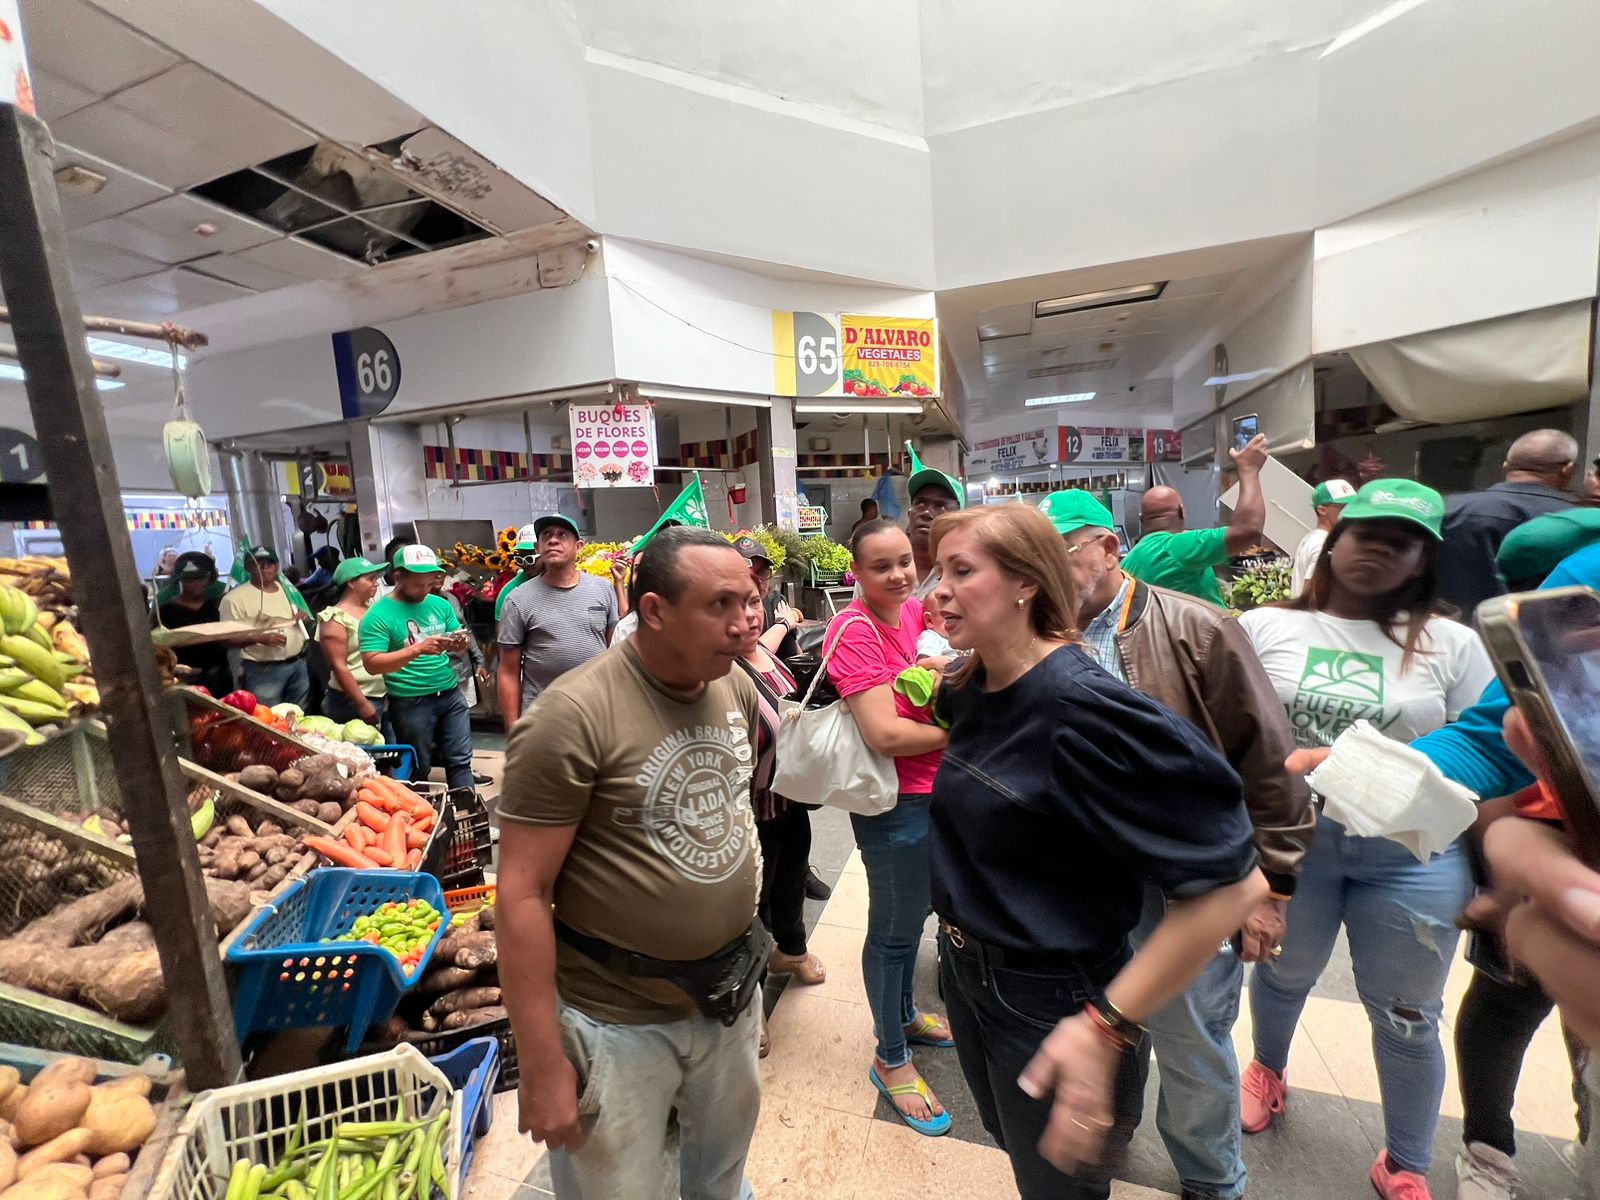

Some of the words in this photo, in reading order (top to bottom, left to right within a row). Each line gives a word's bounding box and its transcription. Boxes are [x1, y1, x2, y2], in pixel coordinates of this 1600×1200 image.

[798, 335, 838, 376] 65
[857, 348, 921, 361] VEGETALES
[357, 349, 393, 394] 66
[578, 409, 641, 426] BUQUES
[575, 427, 592, 439] DE
[597, 426, 646, 438] FLORES
[1066, 435, 1079, 454] 12
[1101, 436, 1119, 447] FELIX
[1153, 437, 1164, 454] 13
[997, 445, 1017, 458] FELIX
[1293, 691, 1385, 725] FUERZA
[635, 727, 695, 787] ORIGINAL
[726, 710, 754, 785] LADA
[659, 763, 687, 805] NEW
[686, 751, 724, 770] YORK
[687, 788, 727, 815] LADA
[659, 825, 744, 869] COLLECTION
